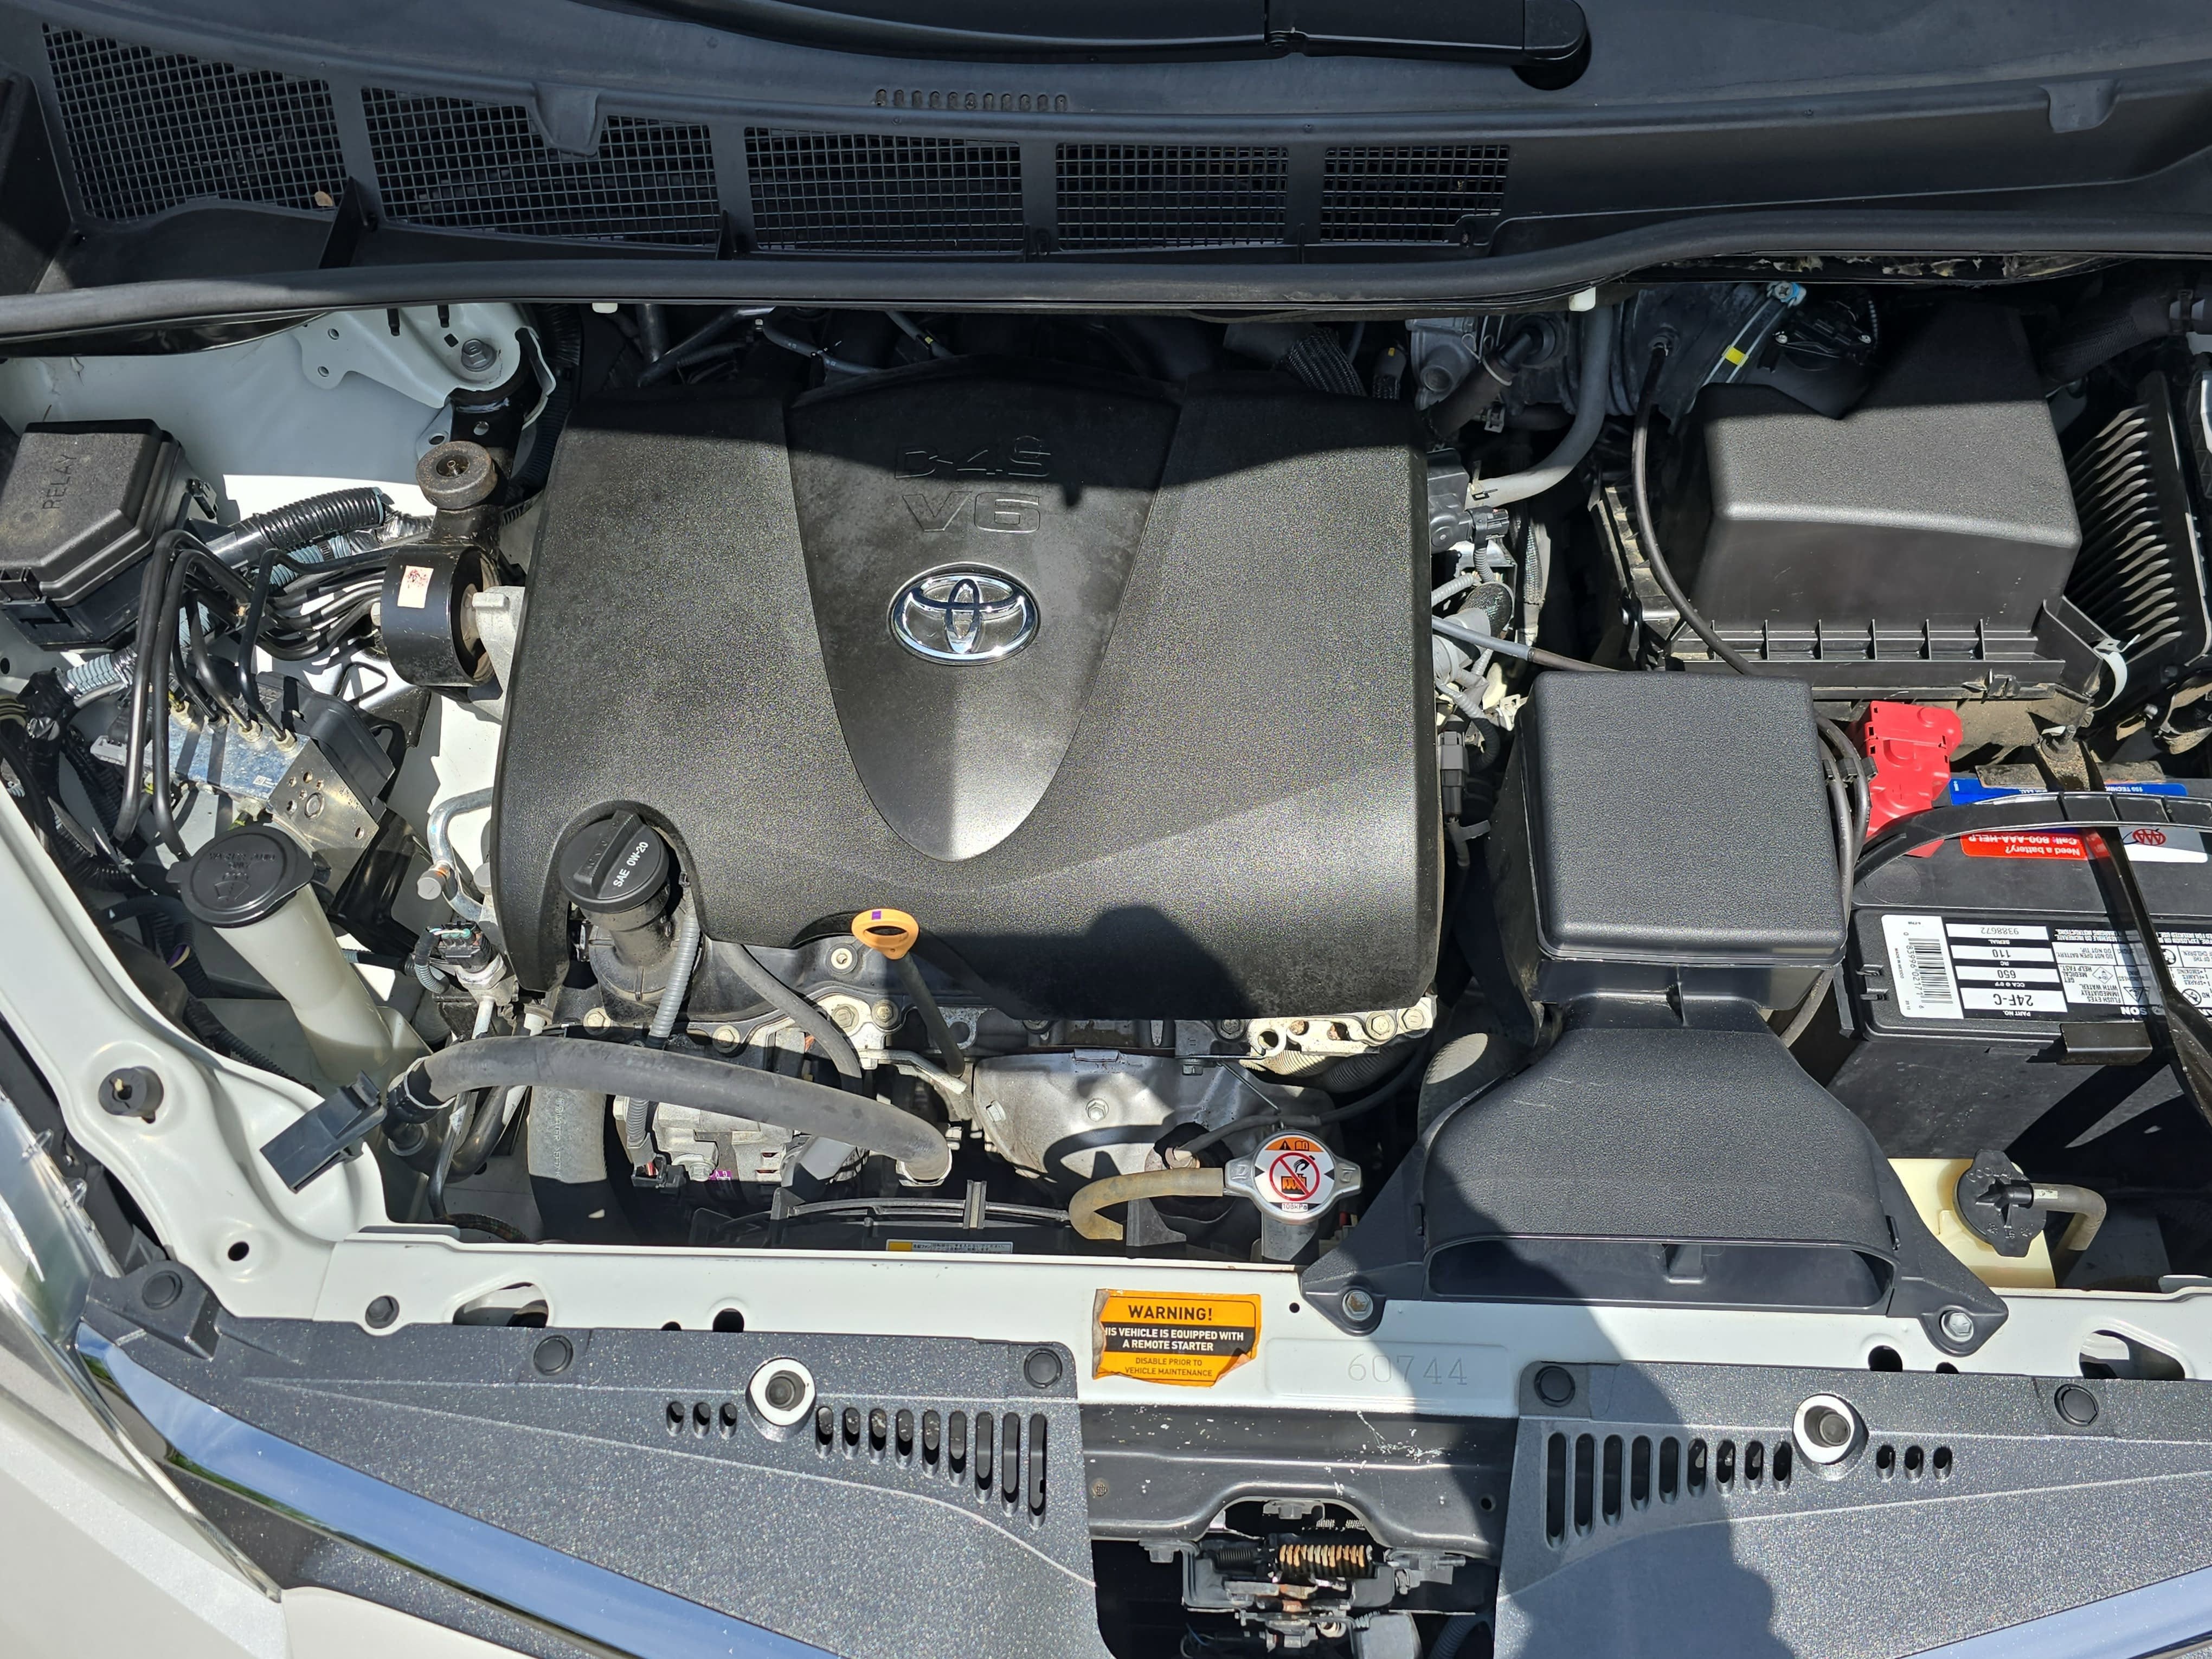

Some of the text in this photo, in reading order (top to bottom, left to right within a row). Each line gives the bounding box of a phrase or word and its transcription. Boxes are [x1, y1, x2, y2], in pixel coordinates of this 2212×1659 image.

[42, 454, 76, 510] RELAY
[902, 491, 1040, 533] V6
[1968, 834, 2077, 845] Call: 800-AAA-HELP
[2134, 829, 2162, 845] AAA
[2005, 845, 2046, 854] battery?
[2053, 847, 2080, 856] Need
[613, 842, 648, 887] SAE 0W-20
[1992, 949, 2011, 958] 110
[1906, 946, 1918, 968] 83996
[1912, 972, 1923, 996] 02171
[1997, 969, 2016, 979] 650
[1993, 994, 2034, 1006] 24F-C
[1128, 1304, 1212, 1321] WARNING!
[1105, 1327, 1244, 1341] HIS VEHICLE IS EQUIPPED WITH
[1123, 1339, 1213, 1351] A REMOTE STARTER
[1348, 1353, 1467, 1385] 60744
